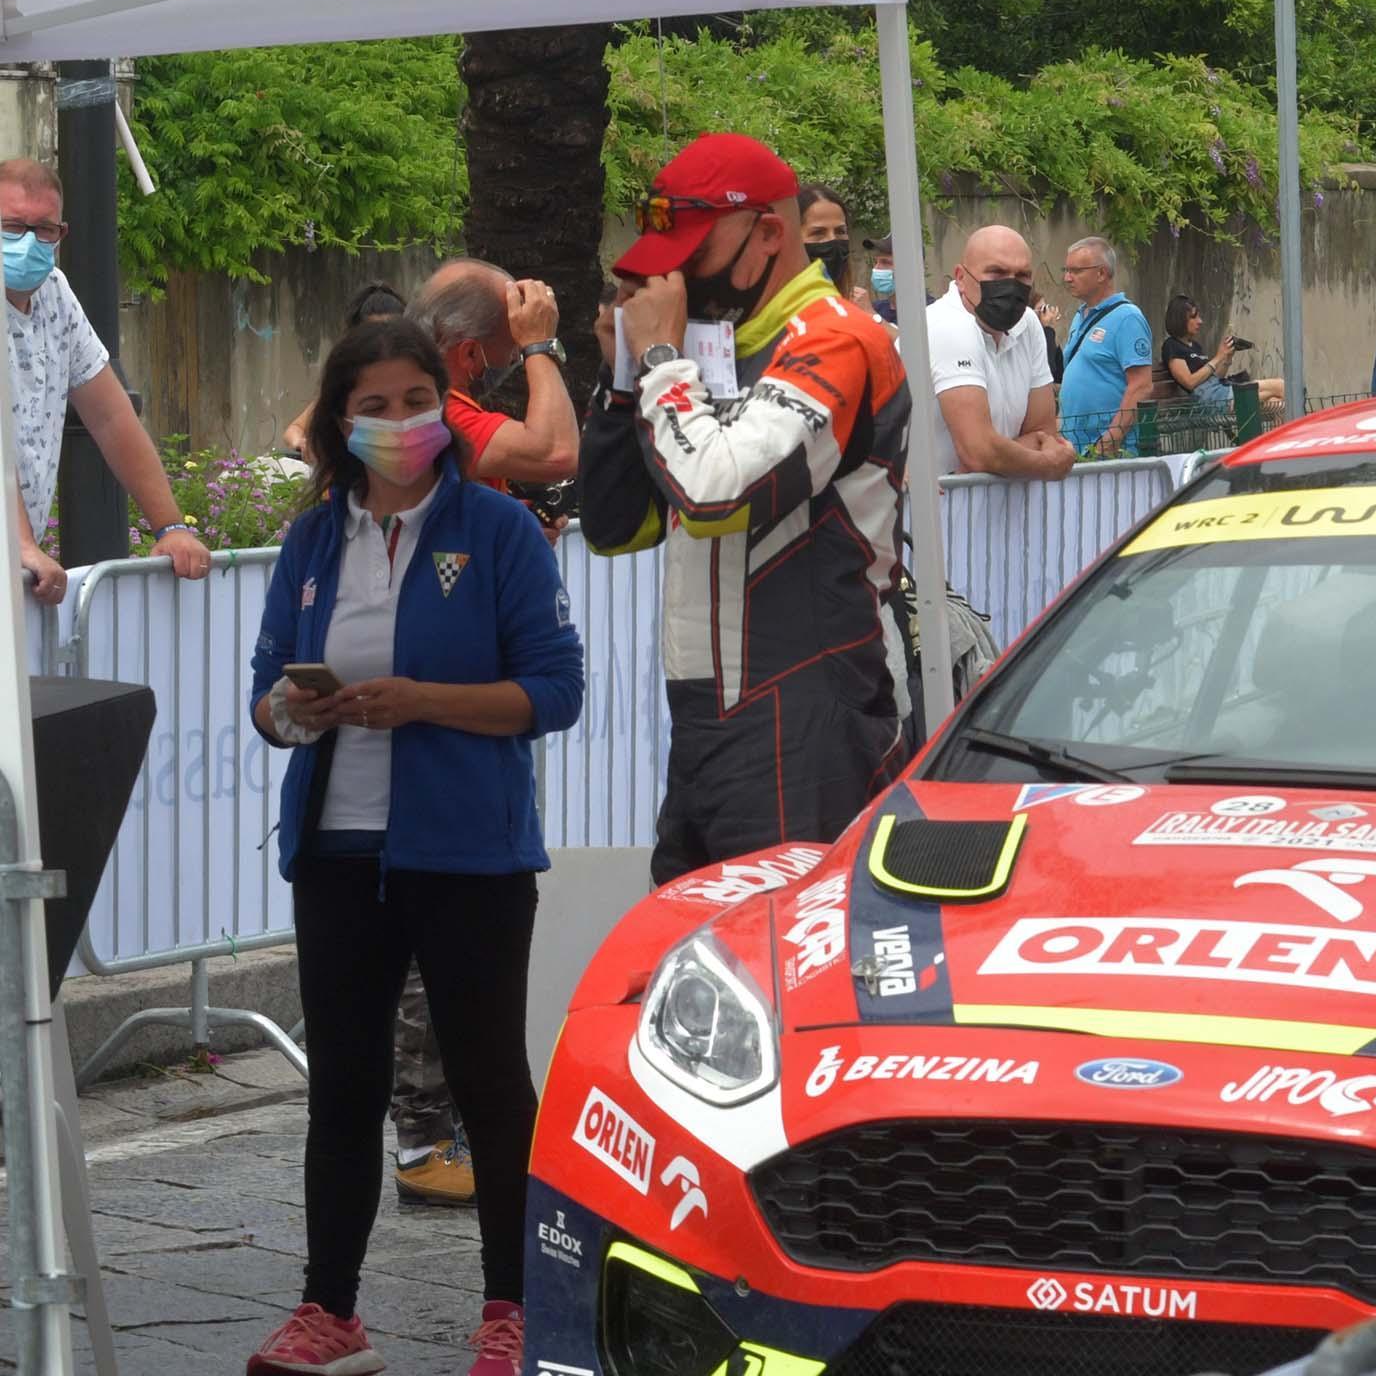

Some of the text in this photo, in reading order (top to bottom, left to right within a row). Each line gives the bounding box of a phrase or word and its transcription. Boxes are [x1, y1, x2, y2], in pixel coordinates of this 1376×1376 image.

[1174, 513, 1236, 532] WRC
[1240, 511, 1259, 525] 2
[1221, 800, 1275, 813] 28
[1157, 813, 1248, 834] RALLY
[1240, 818, 1331, 838] ITALIA
[1271, 836, 1335, 847] 2021
[842, 1055, 1041, 1085] BENZINA
[1091, 1061, 1165, 1085] Ford
[583, 1100, 650, 1182] ORLEN
[538, 1222, 583, 1256] EDOX
[1073, 1281, 1198, 1319] SATUM
